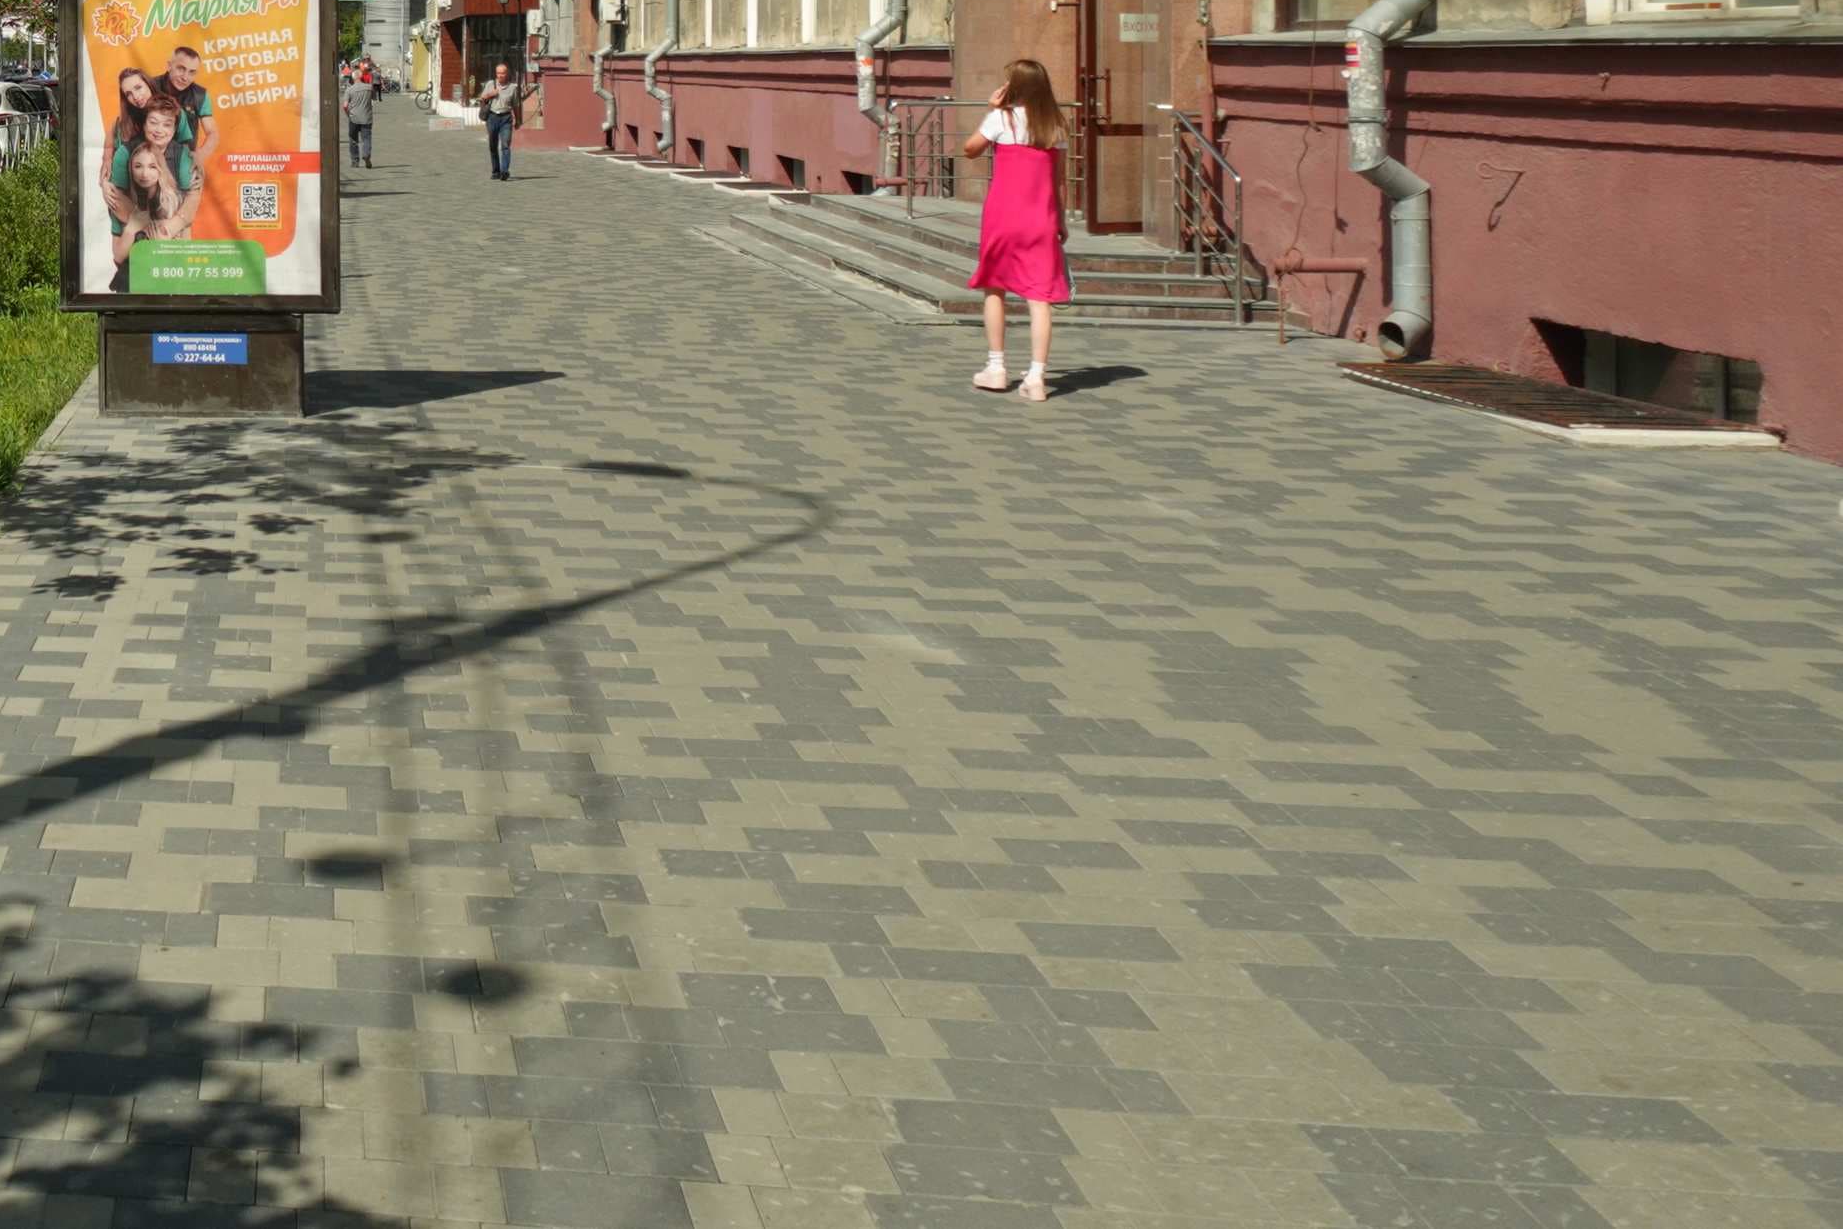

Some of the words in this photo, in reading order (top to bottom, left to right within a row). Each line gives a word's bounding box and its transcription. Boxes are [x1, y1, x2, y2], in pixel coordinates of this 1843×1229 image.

[204, 28, 293, 55] КРУПНАЯ
[204, 46, 299, 73] ТОРГОВАЯ
[230, 72, 278, 88] СЕТЬ
[217, 84, 297, 109] СИБИРИ
[227, 154, 291, 162] ПРИГЛАШАЕМ
[231, 164, 238, 172] В
[239, 164, 285, 173] КОМАНДУ
[152, 267, 160, 278] 8
[163, 267, 184, 278] 800
[188, 267, 203, 278] 77
[222, 267, 244, 278] 999
[184, 353, 225, 363] 227-64-64
